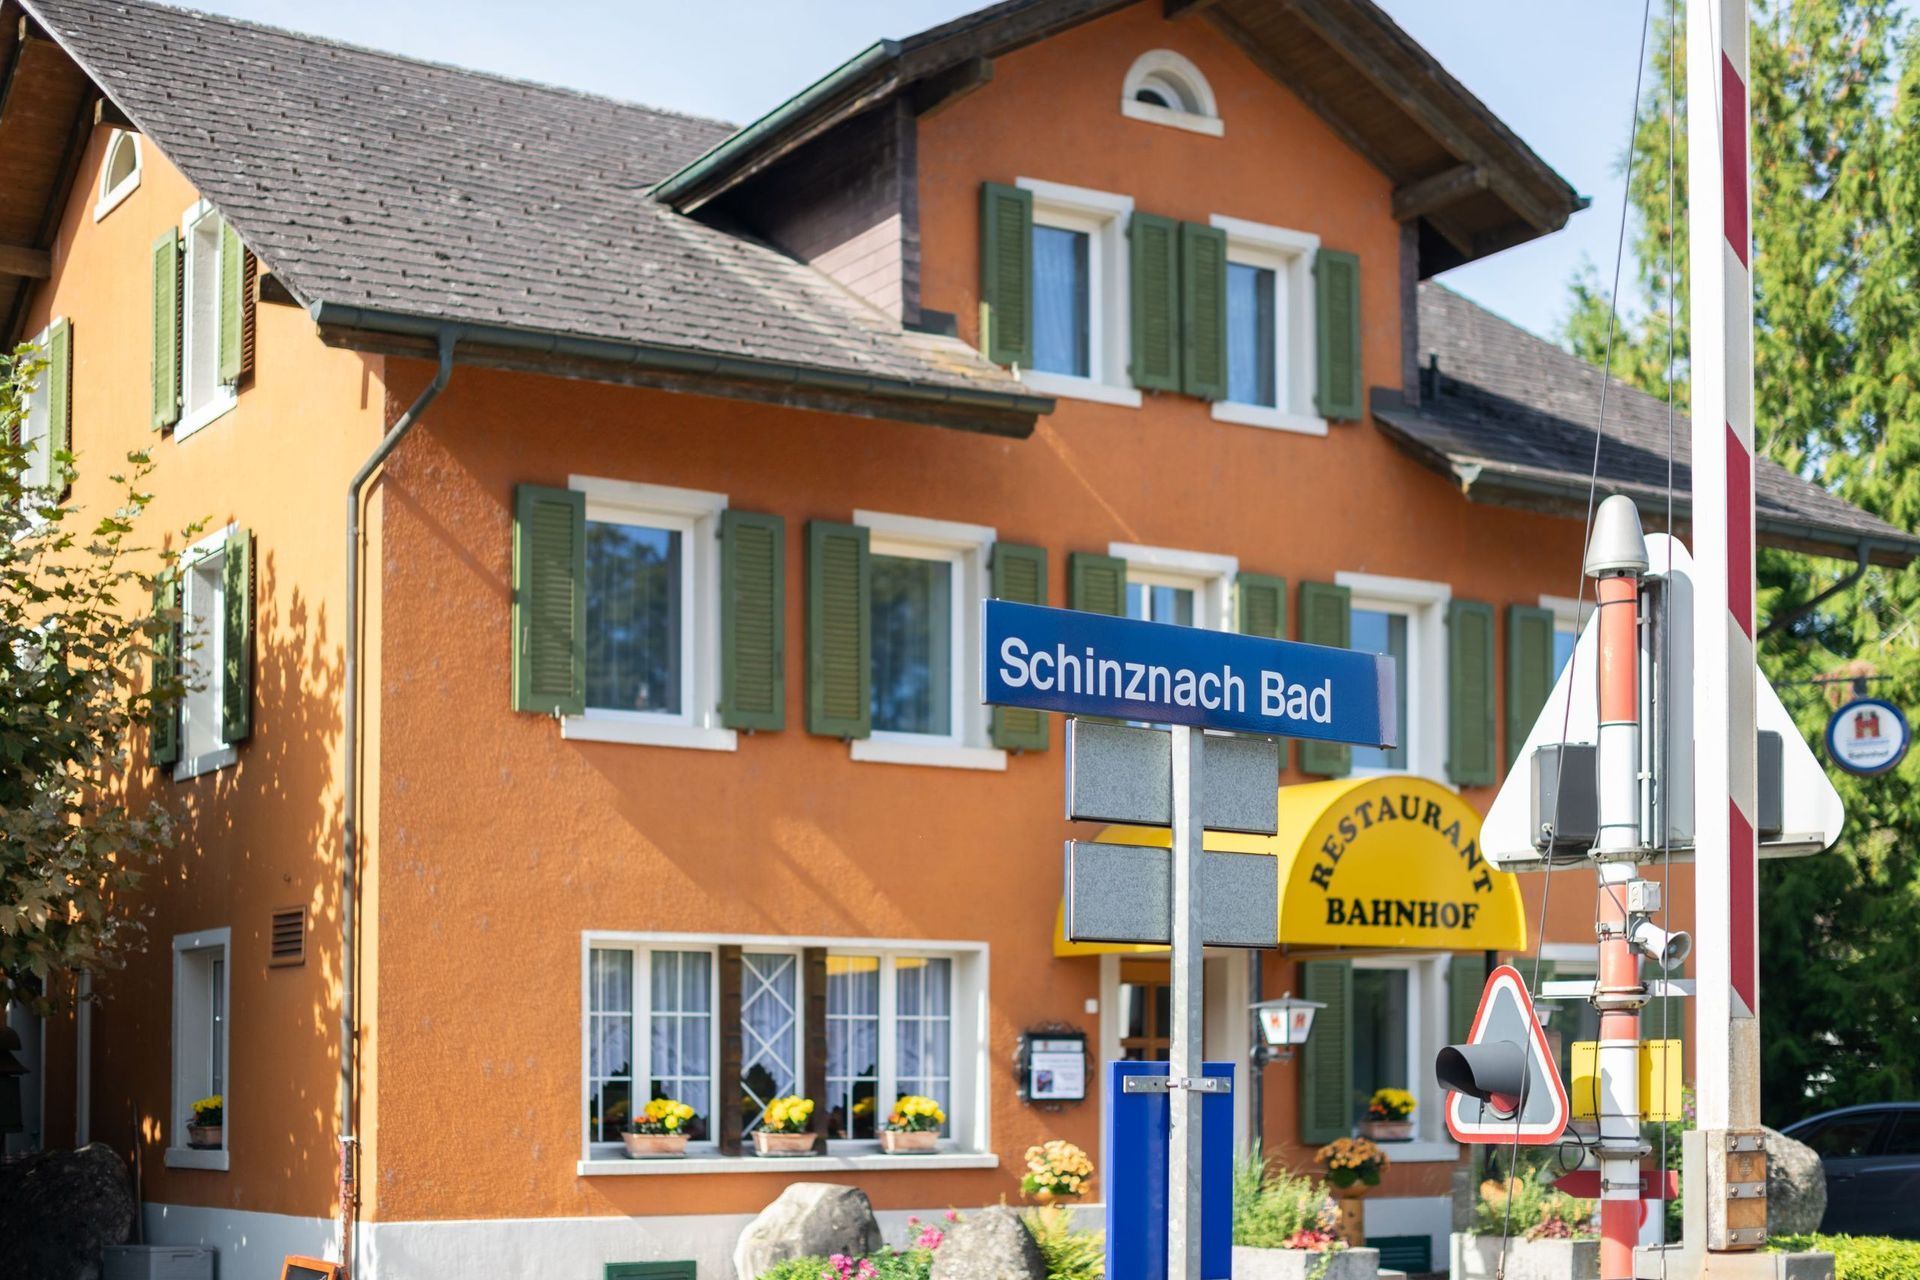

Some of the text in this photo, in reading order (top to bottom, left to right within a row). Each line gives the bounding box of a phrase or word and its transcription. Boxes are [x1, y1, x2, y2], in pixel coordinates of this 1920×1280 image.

[1000, 637, 1332, 723] Schinznach Bad
[1309, 795, 1493, 893] RESTAURANT
[1326, 898, 1479, 929] BAHNHOF
